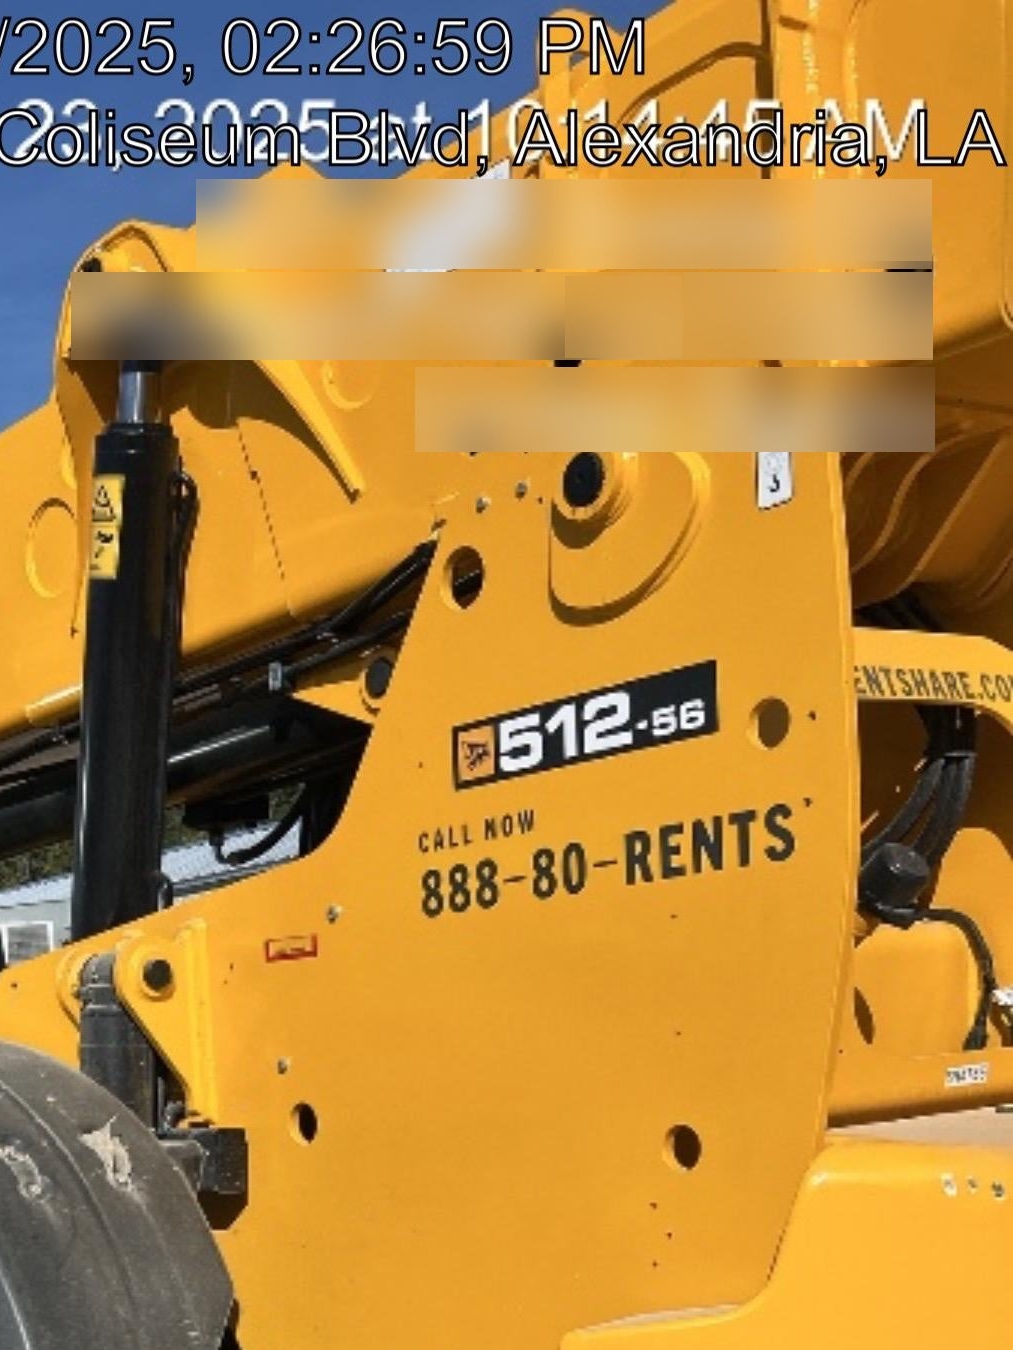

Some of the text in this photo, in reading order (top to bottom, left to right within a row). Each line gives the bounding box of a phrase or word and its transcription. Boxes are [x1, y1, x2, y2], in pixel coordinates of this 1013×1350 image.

[854, 665, 1013, 702] ENTSHARE.CO
[498, 690, 706, 772] 512-56
[418, 808, 535, 854] CALL NOW
[421, 803, 795, 918] 888-80-RENTS
